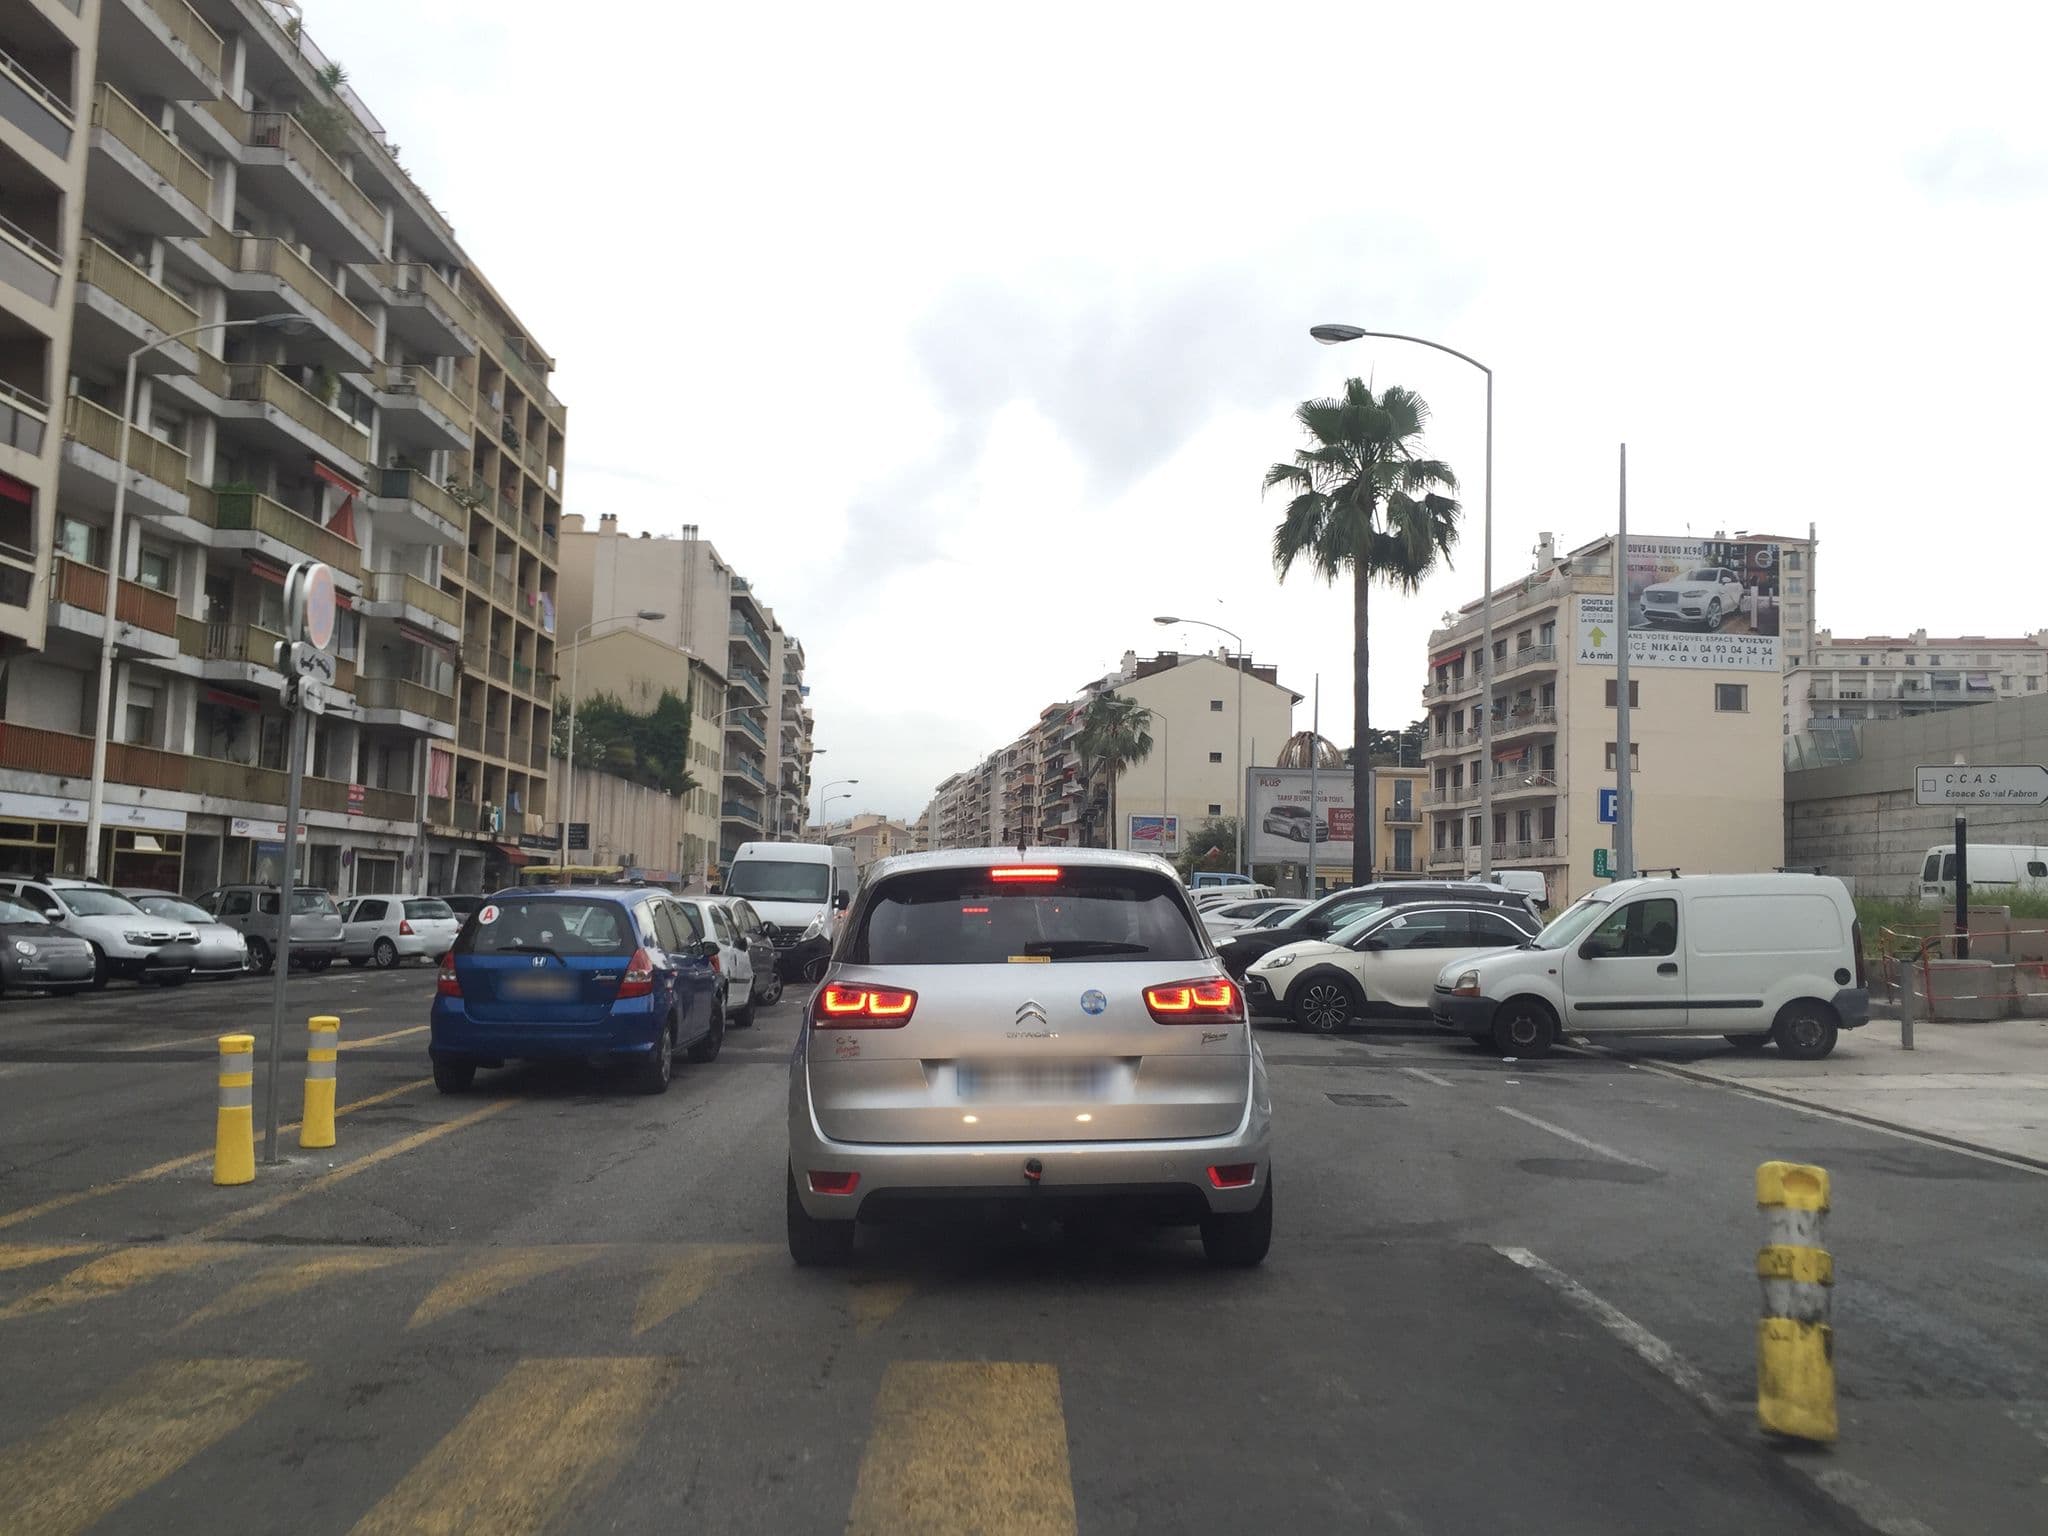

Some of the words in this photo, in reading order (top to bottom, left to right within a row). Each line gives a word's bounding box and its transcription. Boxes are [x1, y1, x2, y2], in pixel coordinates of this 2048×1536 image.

[1627, 543, 1657, 553] OUVEAU
[1659, 545, 1681, 554] VOLVO
[1684, 546, 1702, 555] XC90
[1581, 649, 1587, 658] À
[1589, 651, 1596, 659] 6
[1597, 651, 1613, 659] min
[1630, 642, 1647, 650] ICE
[1700, 644, 1711, 653] 04
[1715, 645, 1727, 653] 93
[1730, 645, 1742, 654] 04
[1746, 646, 1758, 655] 34
[1761, 647, 1773, 655] 34
[2007, 789, 2039, 798] Fabron
[483, 908, 493, 921] A
